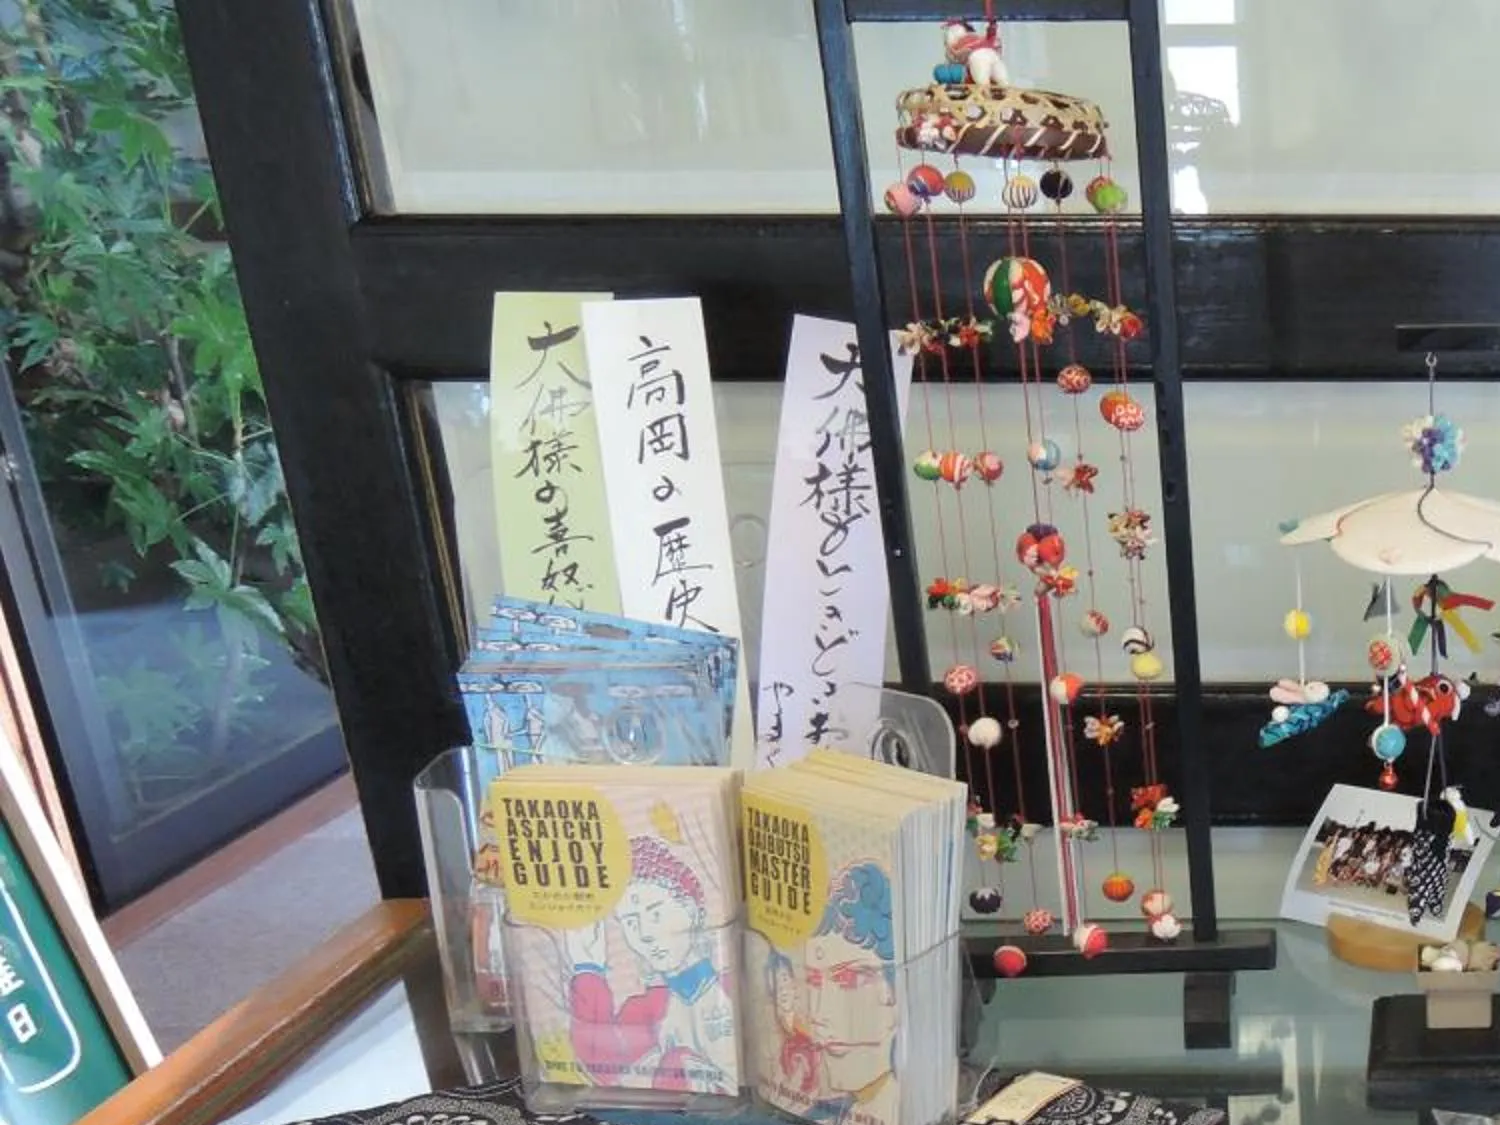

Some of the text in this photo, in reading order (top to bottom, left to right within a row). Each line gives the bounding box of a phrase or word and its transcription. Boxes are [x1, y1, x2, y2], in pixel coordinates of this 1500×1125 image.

[626, 334, 720, 633] 高岡の歴史
[503, 797, 600, 821] TAKAOKA
[747, 806, 810, 844] TAKAOKA
[506, 818, 603, 841] ASAICHI
[747, 827, 811, 866] DAIBUTSU
[508, 838, 605, 865] ENJOY
[749, 848, 811, 890] MASTER
[512, 862, 610, 889] GUIDE
[750, 872, 812, 917] GUIDE
